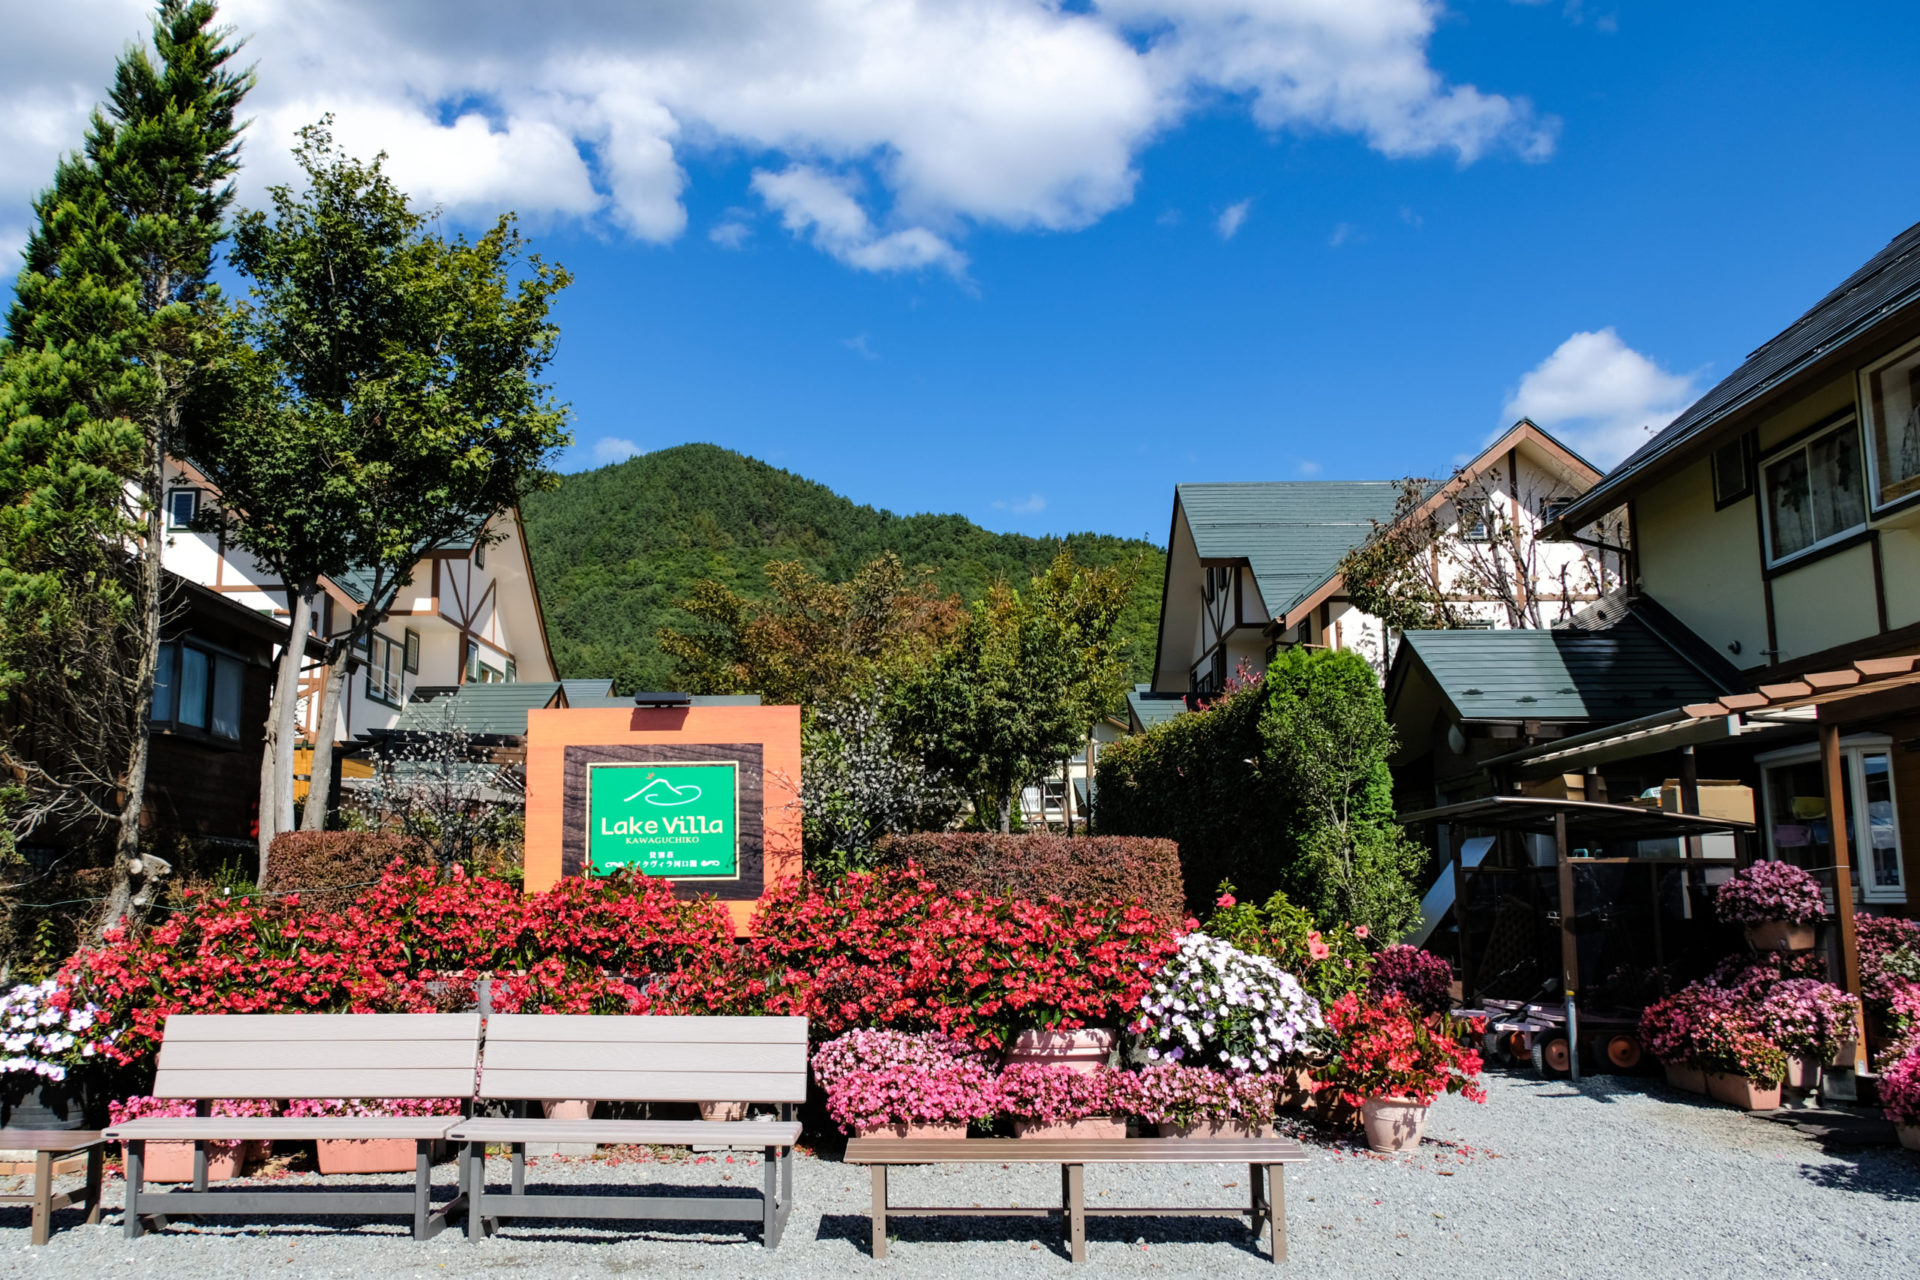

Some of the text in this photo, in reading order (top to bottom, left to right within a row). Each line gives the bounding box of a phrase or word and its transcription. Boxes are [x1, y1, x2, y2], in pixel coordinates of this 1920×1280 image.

[601, 815, 723, 835] Lake Villa
[625, 837, 700, 845] KAWAGUCHIKO
